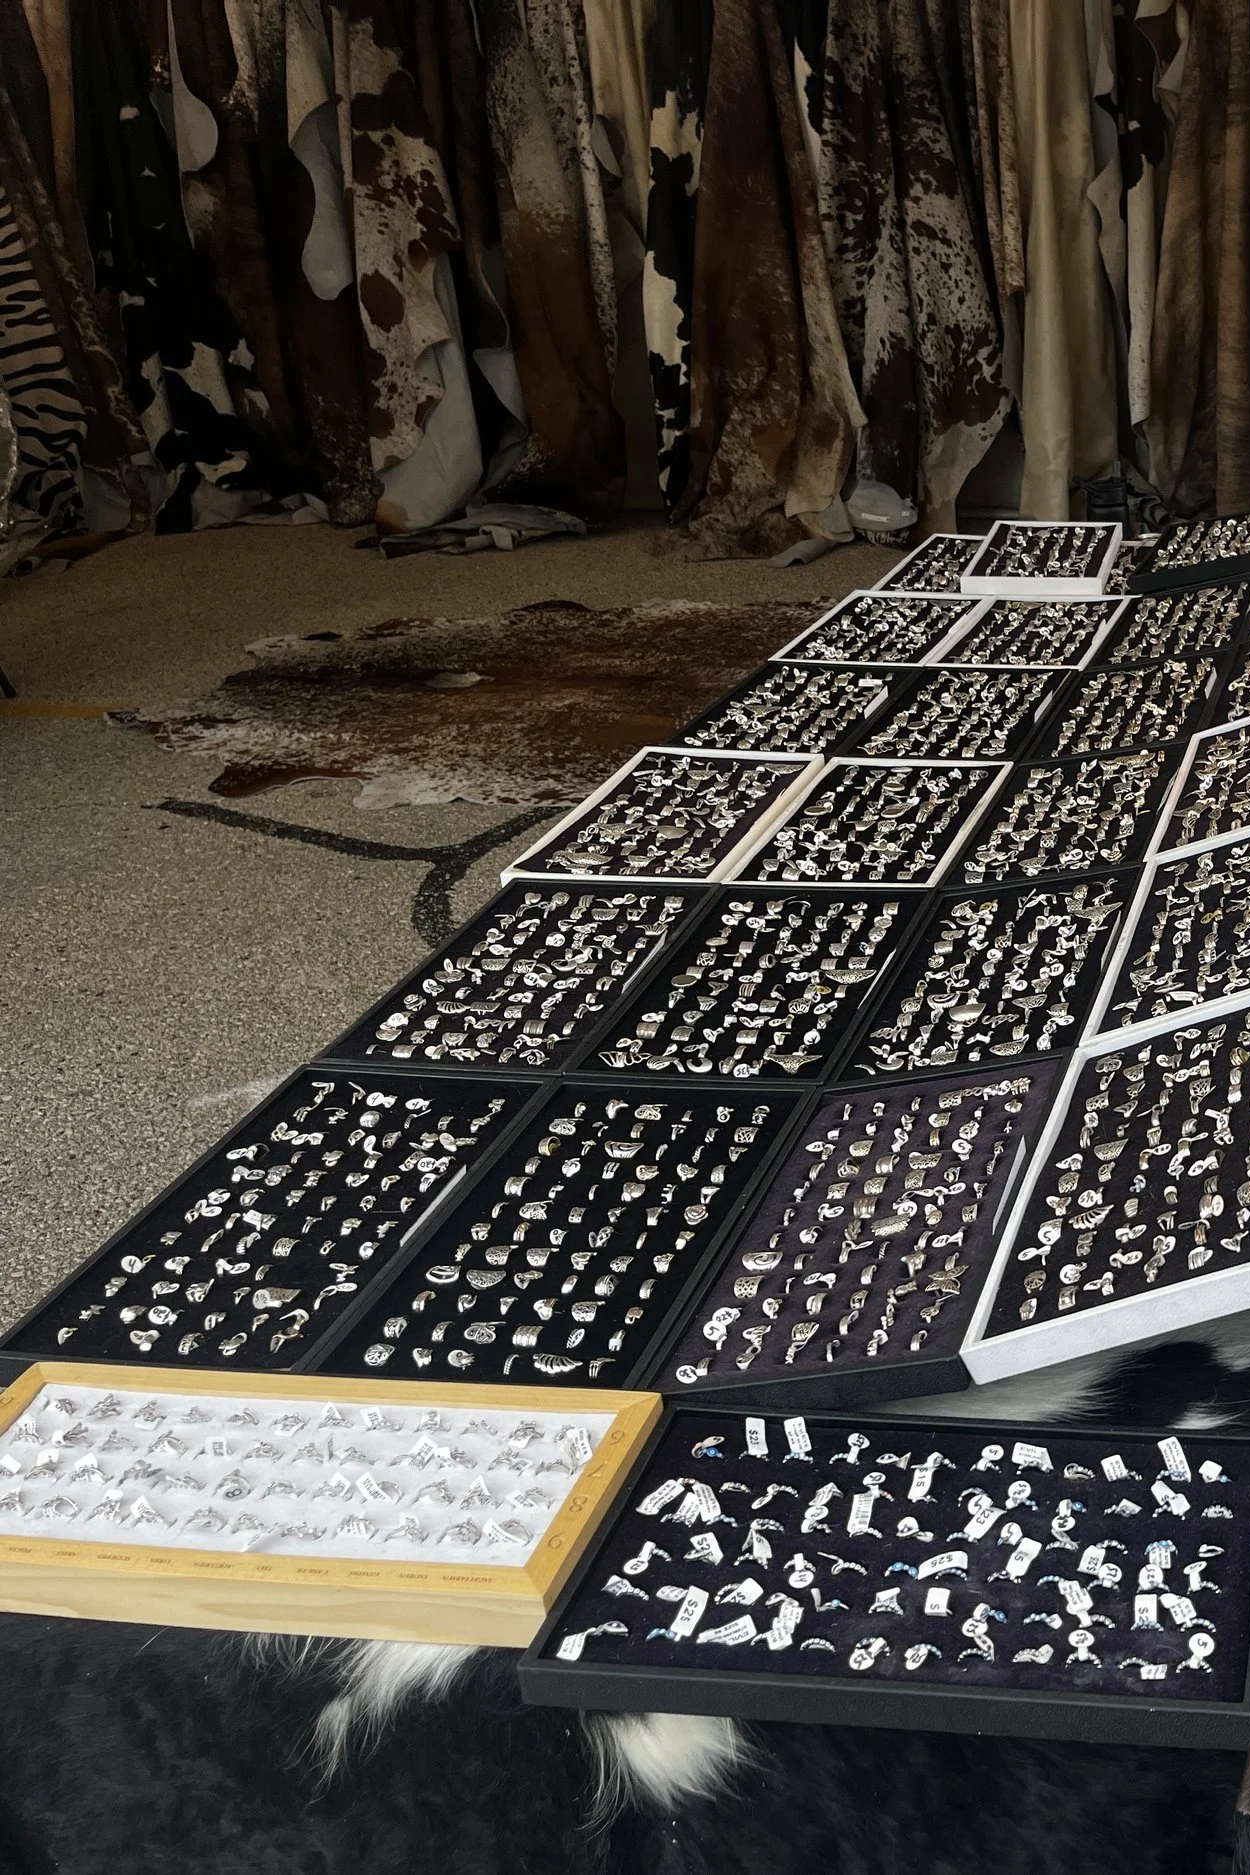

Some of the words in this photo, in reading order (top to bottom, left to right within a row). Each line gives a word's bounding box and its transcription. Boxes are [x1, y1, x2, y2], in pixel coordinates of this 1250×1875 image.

[748, 1429, 760, 1446] $23
[568, 1494, 590, 1514] 8
[930, 1554, 954, 1568] $25
[1088, 1556, 1100, 1572] $25
[678, 1598, 698, 1622] $25
